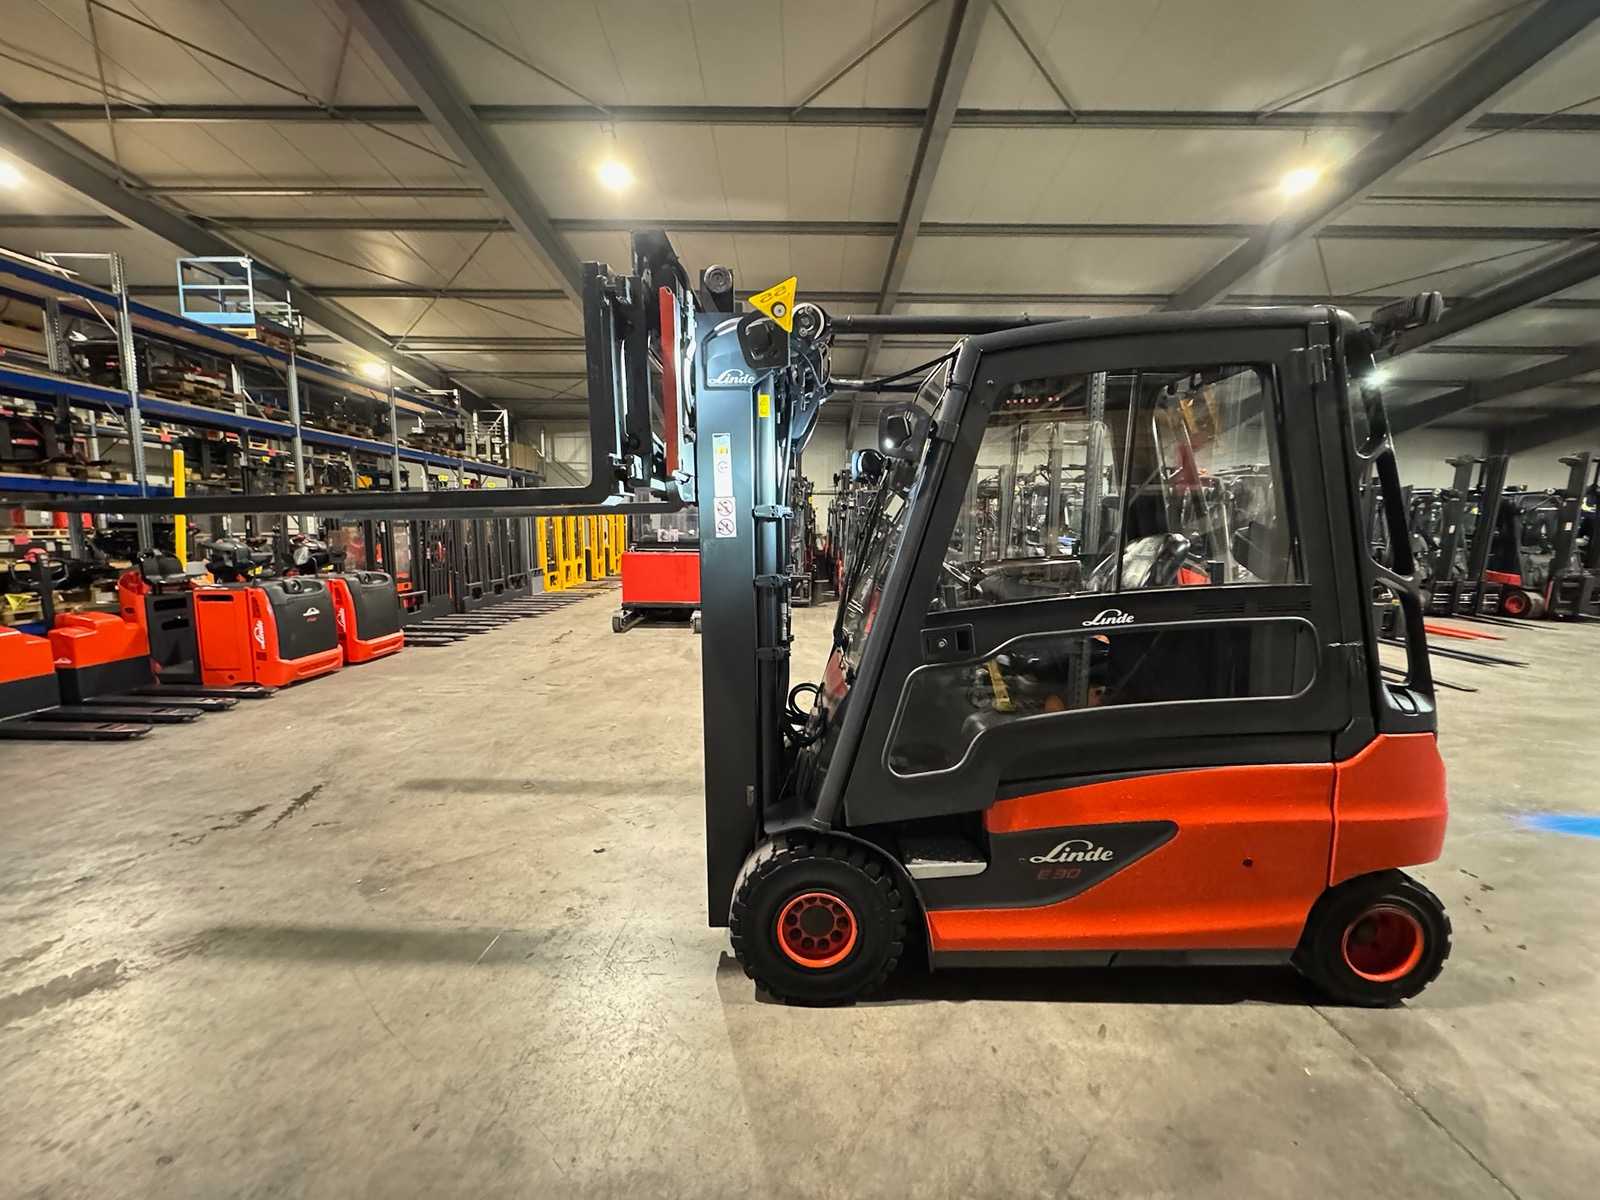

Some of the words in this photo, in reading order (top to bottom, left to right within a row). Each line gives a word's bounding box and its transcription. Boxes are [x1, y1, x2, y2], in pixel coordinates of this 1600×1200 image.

[709, 368, 755, 385] Linde
[1082, 608, 1134, 626] Linde
[1029, 839, 1114, 864] Linde
